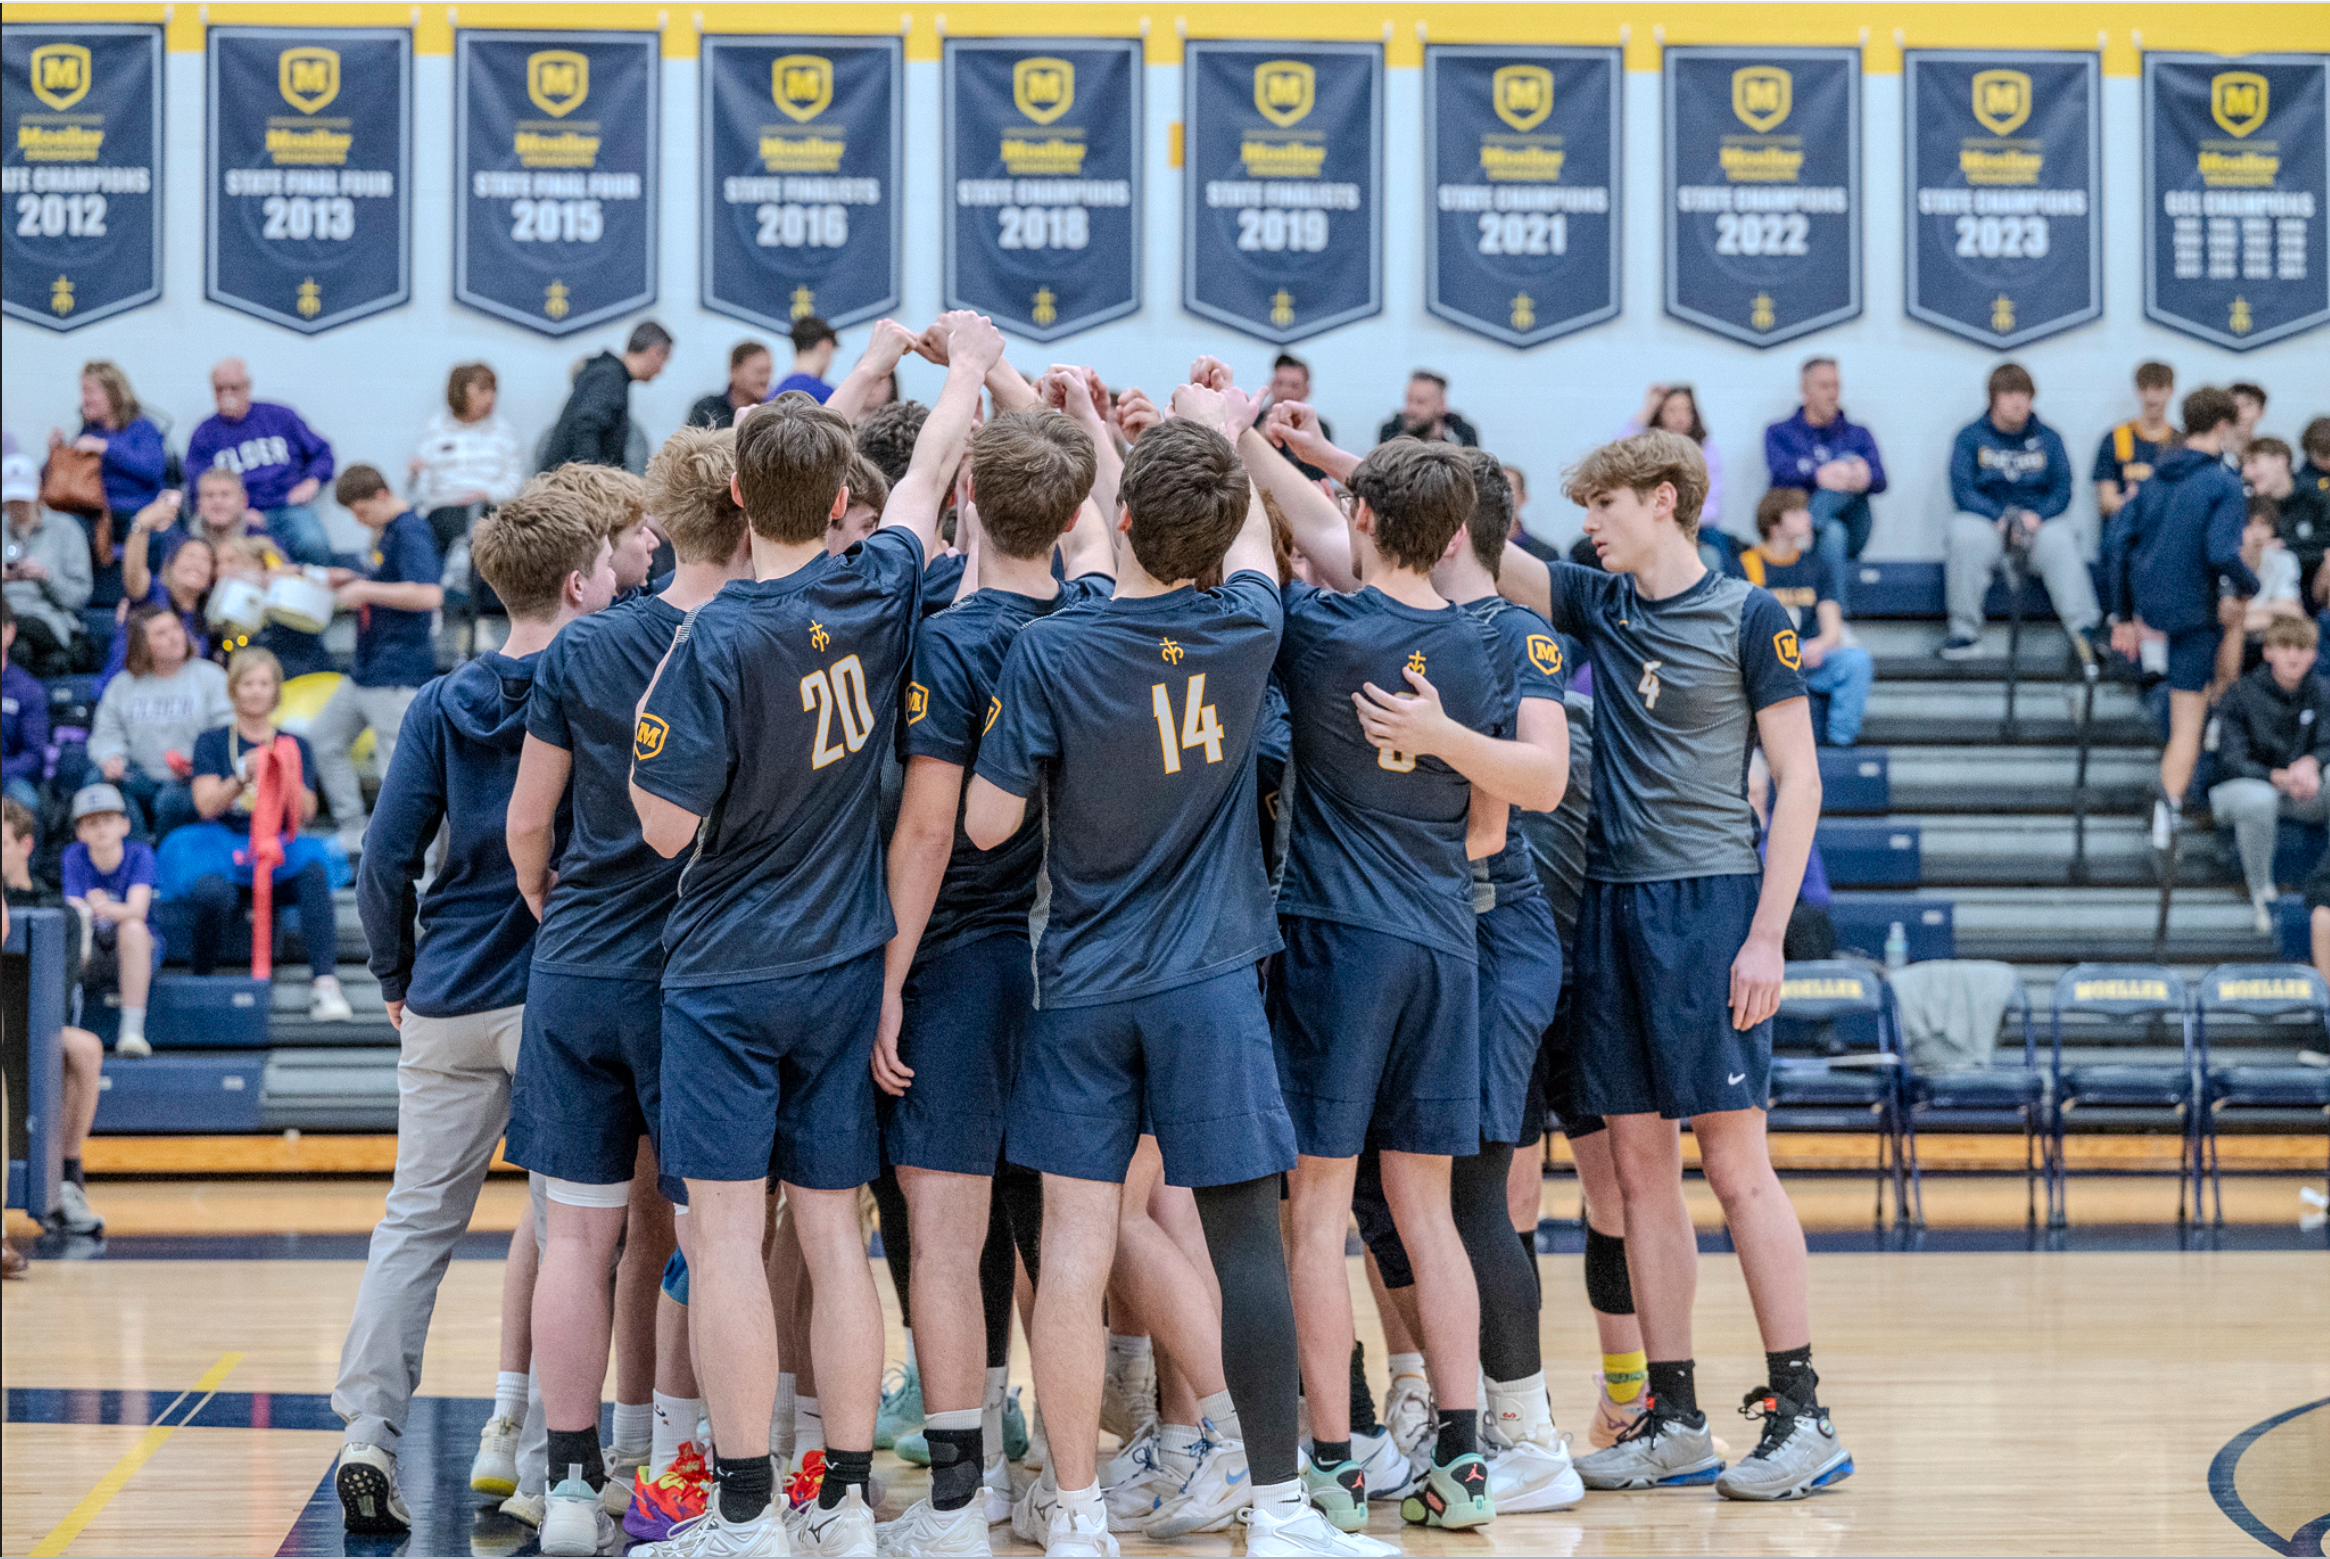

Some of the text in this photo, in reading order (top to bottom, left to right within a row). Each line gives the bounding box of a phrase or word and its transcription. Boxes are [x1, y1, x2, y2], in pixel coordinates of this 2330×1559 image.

[42, 57, 79, 88] M
[292, 60, 327, 91] M
[541, 64, 574, 95] M
[785, 69, 819, 100] M
[1026, 72, 1062, 102] M
[1267, 75, 1300, 105] M
[1507, 81, 1540, 110] M
[1744, 81, 1779, 111] M
[1986, 84, 2019, 115] M
[2224, 85, 2258, 116] M
[33, 167, 150, 194] CHAMPIONS
[16, 194, 107, 237] 2012
[262, 197, 356, 240] 2013
[510, 199, 604, 242] 2015
[755, 204, 849, 247] 2016
[997, 207, 1089, 249] 2018
[1237, 209, 1328, 252] 2019
[1478, 213, 1567, 255] 2021
[1716, 213, 1809, 256] 2022
[1955, 215, 2049, 259] 2023
[1538, 641, 1557, 663] M
[1637, 659, 1662, 710] 4
[799, 654, 875, 770] 20
[1151, 672, 1225, 774] 14
[636, 721, 662, 749] M
[2074, 980, 2170, 1001] MOELLER
[2218, 979, 2313, 1001] MOELLER
